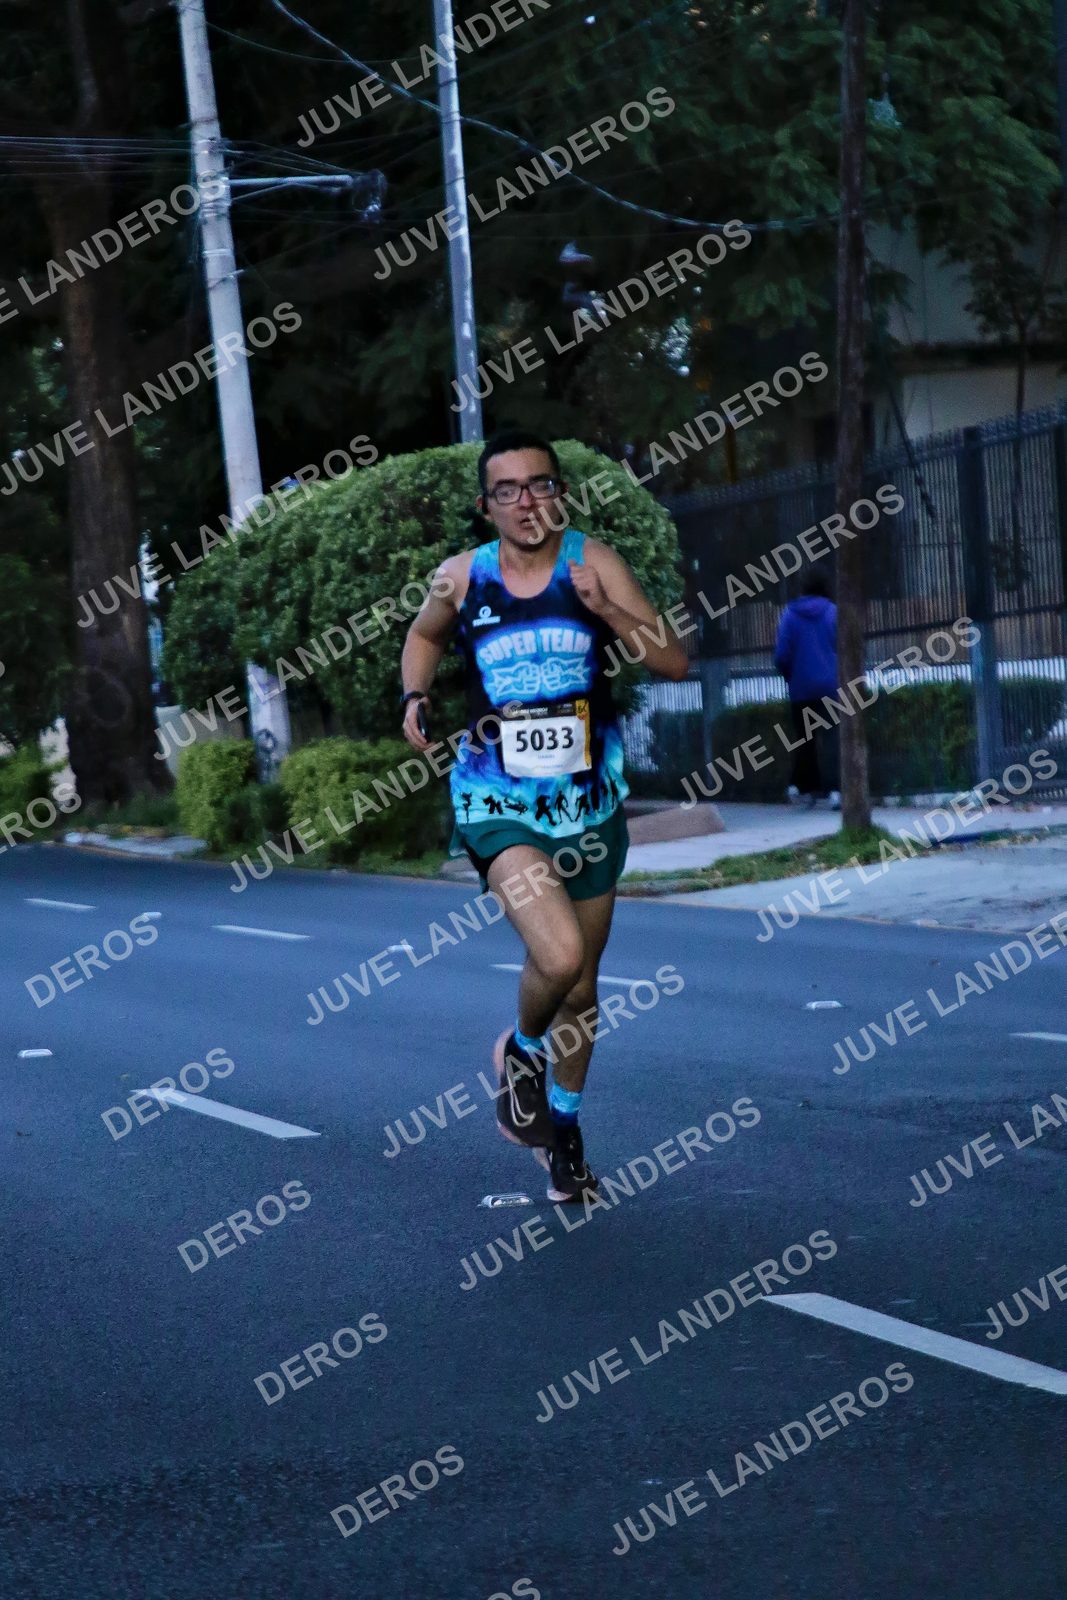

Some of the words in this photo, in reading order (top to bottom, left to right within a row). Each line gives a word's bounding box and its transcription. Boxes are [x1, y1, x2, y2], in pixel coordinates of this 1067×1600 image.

[479, 629, 537, 665] SUPER
[540, 627, 592, 654] TEAM
[516, 726, 575, 752] 5033
